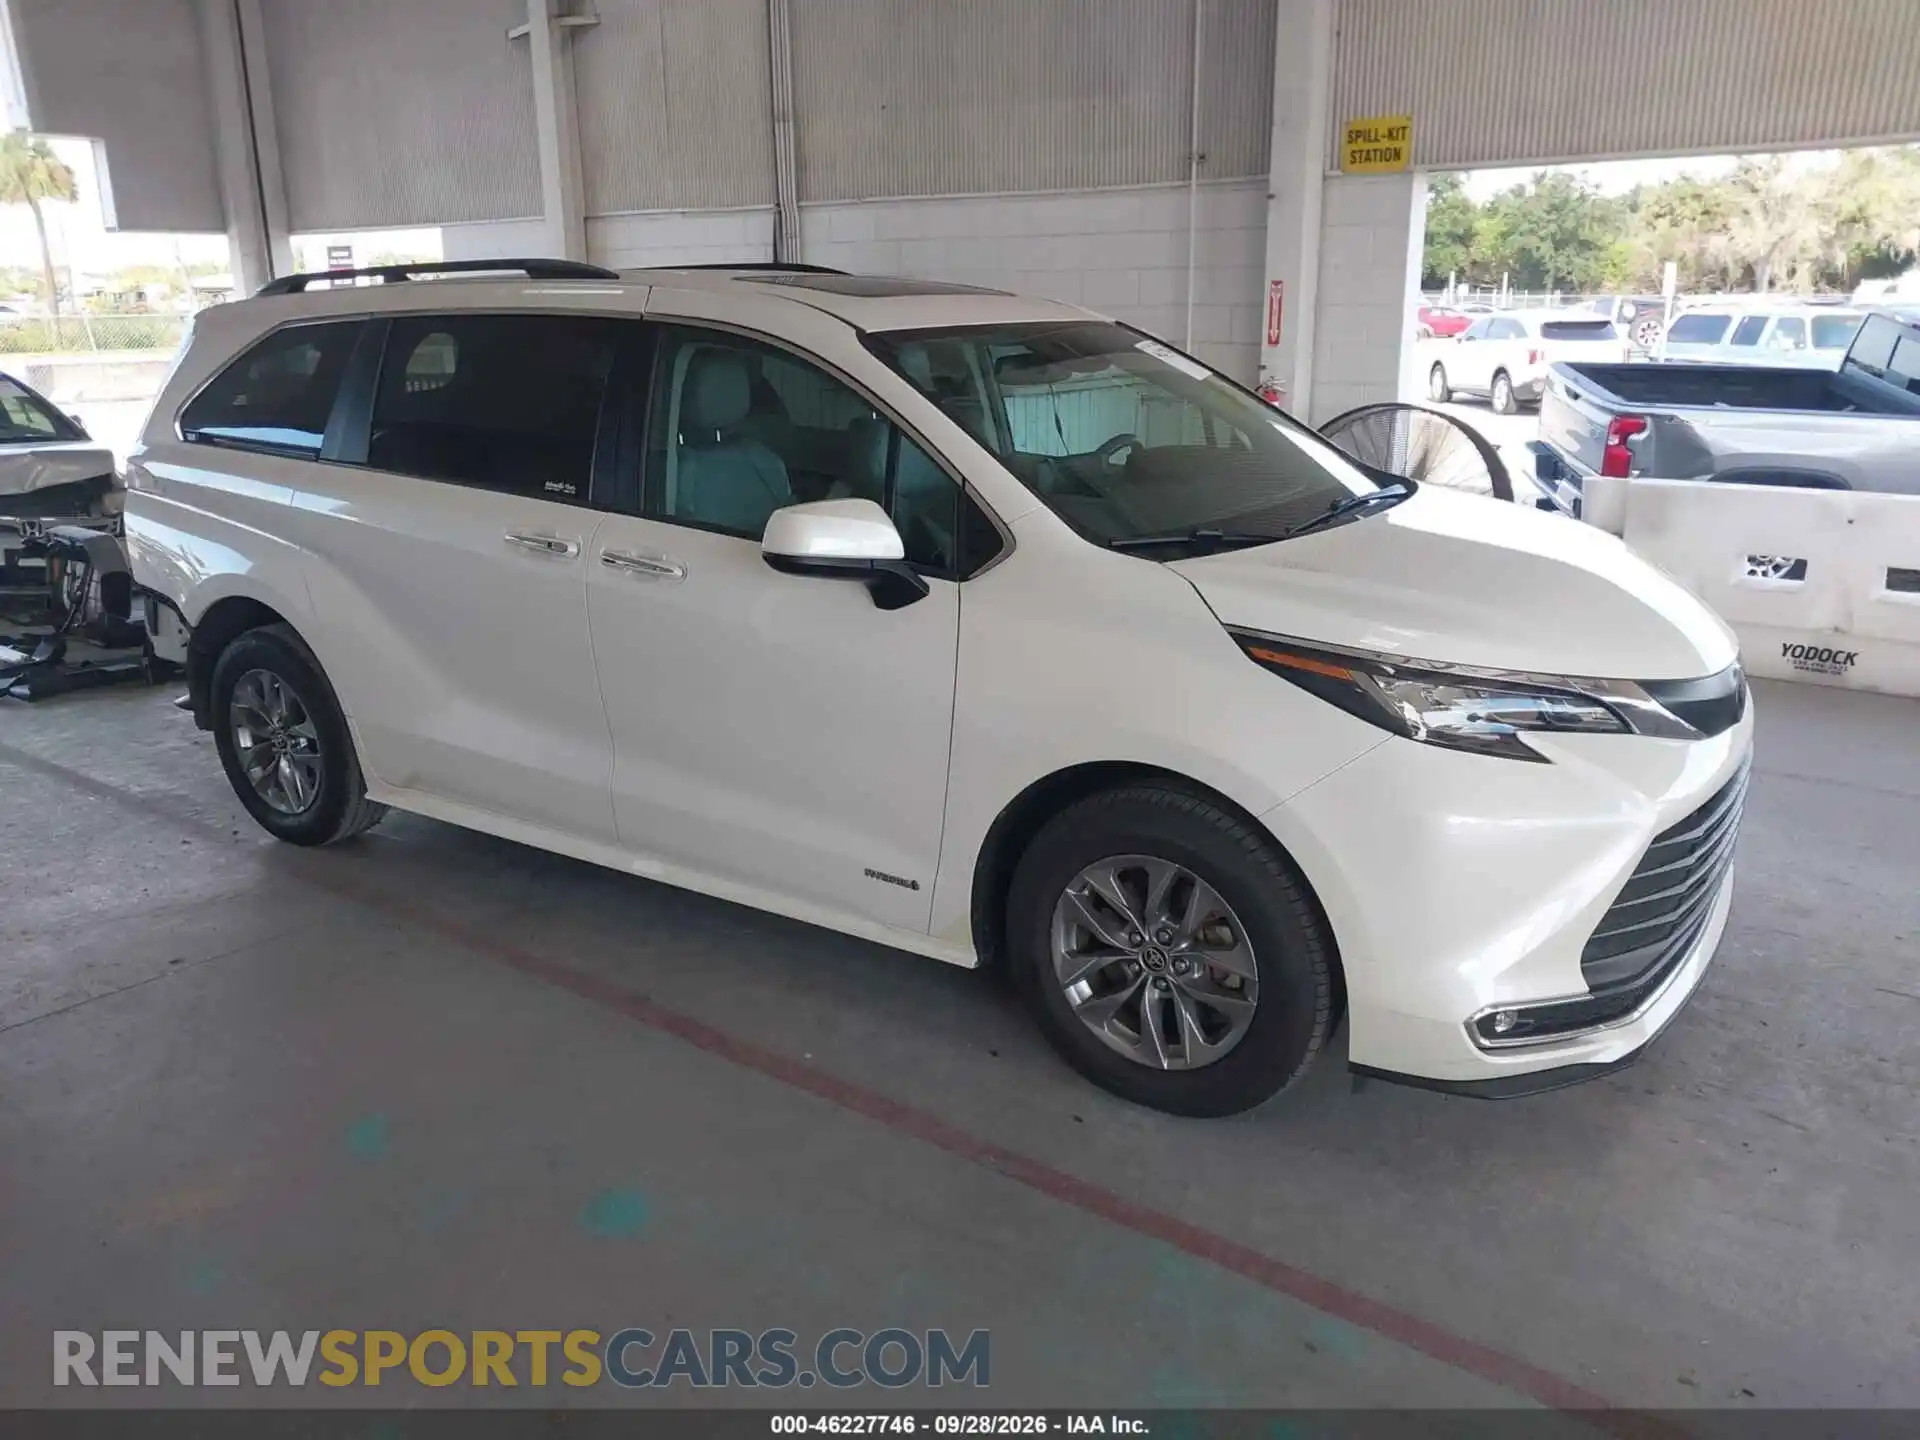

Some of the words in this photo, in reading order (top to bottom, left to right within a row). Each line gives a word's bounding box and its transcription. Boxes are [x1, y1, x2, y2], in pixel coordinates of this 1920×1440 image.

[1347, 126, 1409, 144] SPILL-KIT
[1349, 147, 1402, 166] STATION
[1781, 643, 1859, 666] YODOCK
